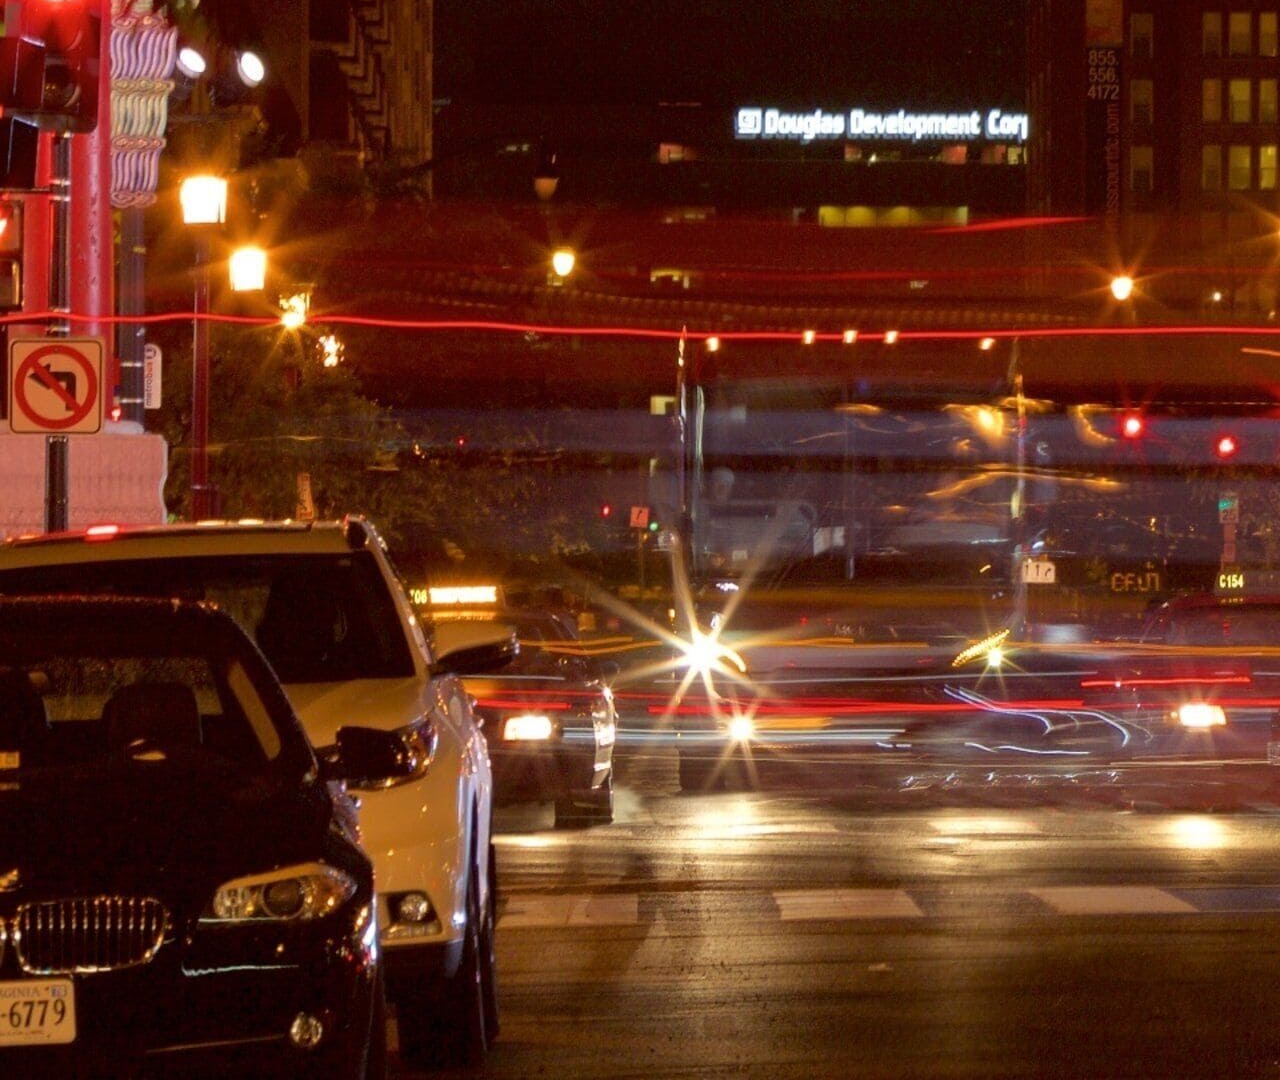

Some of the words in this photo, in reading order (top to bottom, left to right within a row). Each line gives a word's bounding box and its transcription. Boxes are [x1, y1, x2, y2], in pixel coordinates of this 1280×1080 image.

[764, 108, 846, 139] Douglas
[850, 108, 981, 139] Development
[1219, 574, 1244, 588] C154
